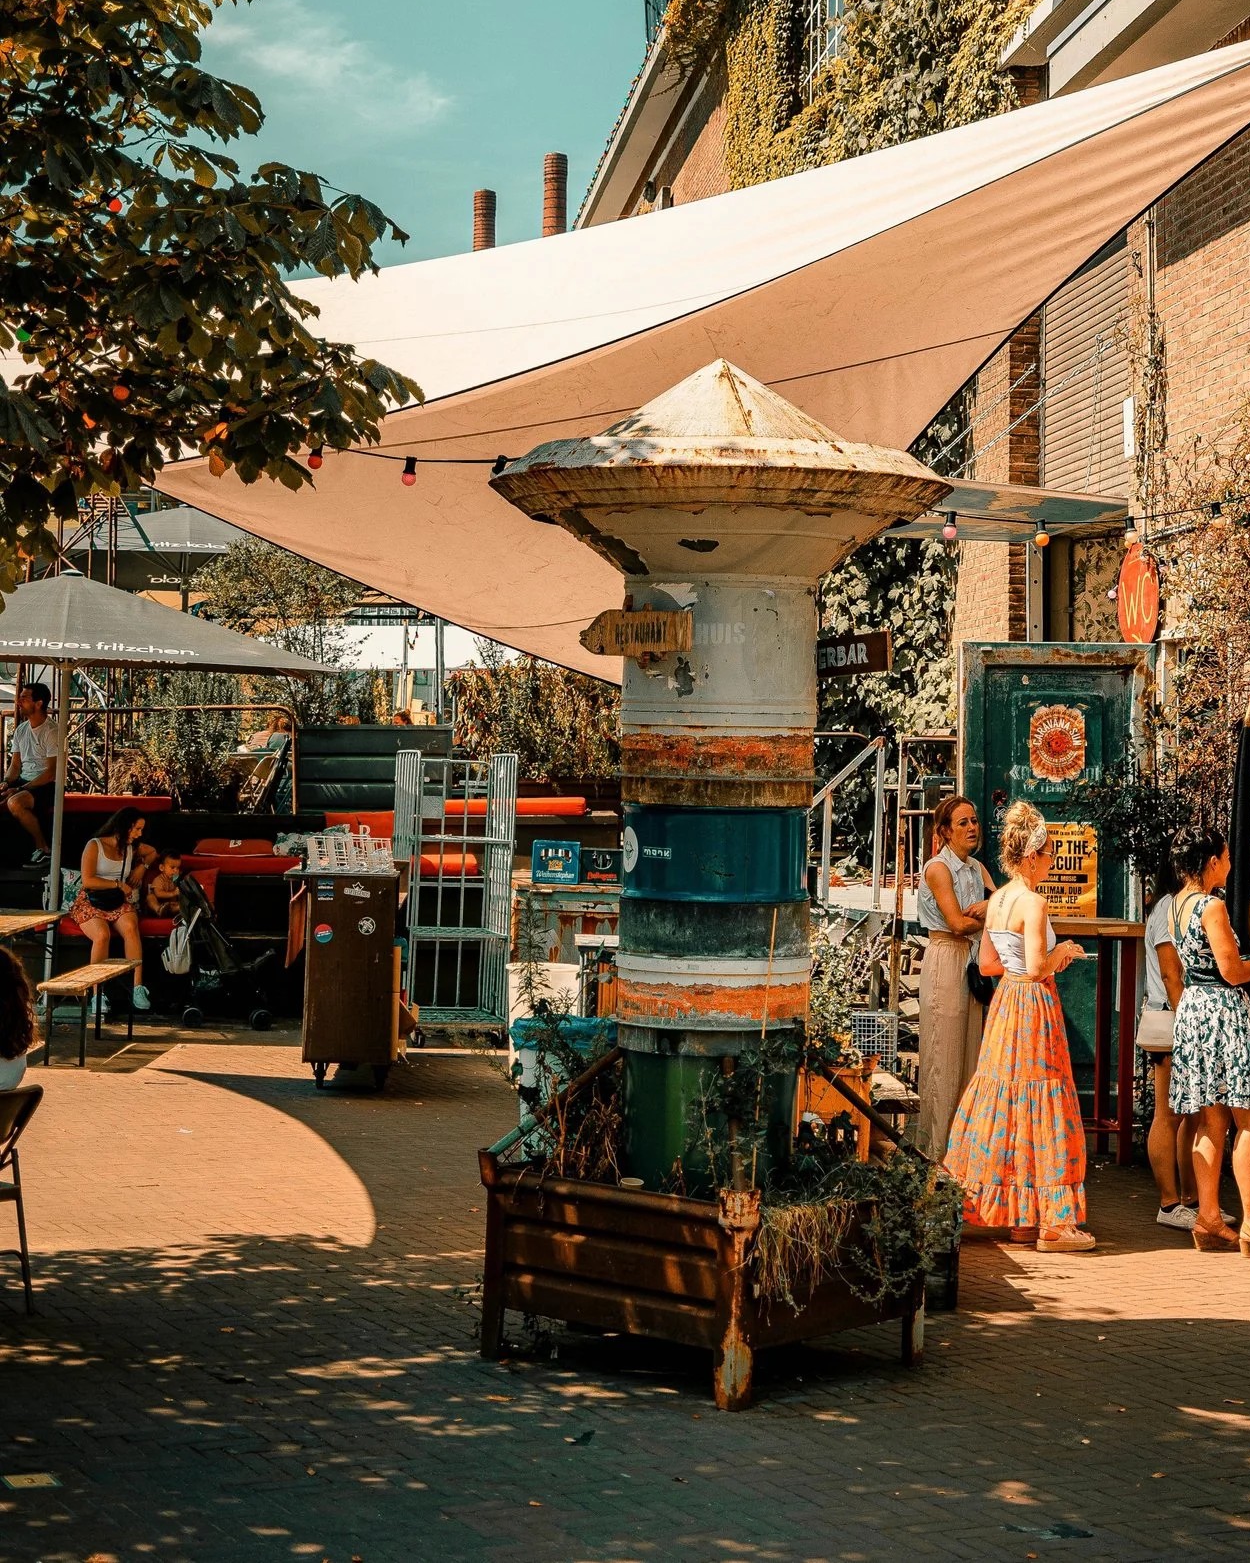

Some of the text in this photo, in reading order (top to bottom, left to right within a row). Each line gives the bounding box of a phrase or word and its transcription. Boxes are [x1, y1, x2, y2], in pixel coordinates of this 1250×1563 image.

[1122, 574, 1154, 628] WC
[615, 620, 667, 646] RESTAURANT
[1032, 717, 1083, 747] CARAVANA SUN
[1066, 839, 1089, 855] THE
[1068, 886, 1082, 895] DUB
